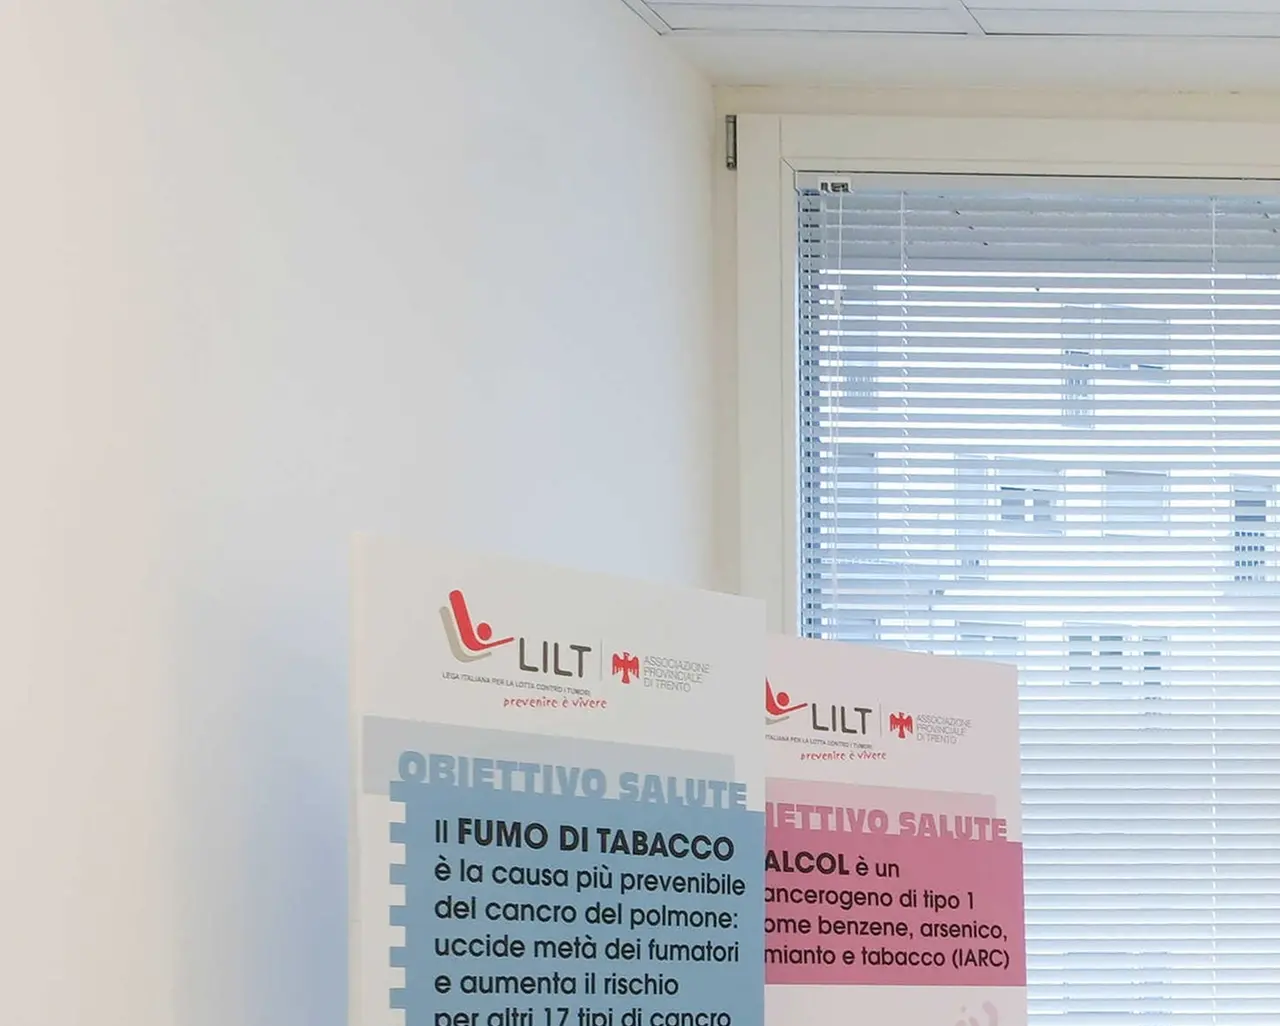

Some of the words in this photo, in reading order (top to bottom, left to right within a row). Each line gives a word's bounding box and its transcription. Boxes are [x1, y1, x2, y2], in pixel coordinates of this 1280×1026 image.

[519, 637, 592, 678] LILT
[644, 655, 711, 674] ASSOCIAZIONE
[644, 667, 704, 684] PROVINCIALE
[644, 679, 654, 688] DI
[655, 680, 691, 693] TRENTO
[503, 696, 558, 708] prevenire
[562, 696, 569, 707] è
[572, 698, 607, 709] vivere
[812, 703, 872, 735] LILT
[398, 751, 606, 799] OBIETTIVO
[619, 772, 746, 809] SALUTE
[436, 820, 448, 843] Il
[458, 818, 548, 849] FUMO
[560, 825, 588, 852] DI
[596, 828, 734, 861] TABACCO
[899, 811, 1008, 841] SALUTE
[434, 854, 451, 881] è
[460, 858, 483, 883] la
[492, 866, 568, 887] causa
[577, 864, 612, 893] più
[621, 872, 745, 896] prevenibile
[856, 855, 869, 876] è
[875, 863, 899, 878] un
[434, 895, 476, 919] del
[485, 902, 577, 923] cancro
[585, 901, 622, 924] del
[630, 905, 738, 930] polmone:
[899, 889, 917, 908] di
[923, 889, 960, 913] tipo
[968, 892, 973, 909] 1
[818, 915, 913, 940] benzene,
[920, 920, 1007, 942] arsenico,
[435, 934, 525, 958] uccide
[534, 934, 597, 959] metà
[605, 938, 641, 960] dei
[648, 938, 739, 962] fumatori
[842, 950, 855, 965] e
[861, 946, 945, 966] tabacco
[952, 948, 1009, 970] (IARC)
[434, 975, 451, 994] e
[460, 972, 576, 994] aumenta
[585, 972, 596, 994] il
[604, 973, 678, 995] rischio
